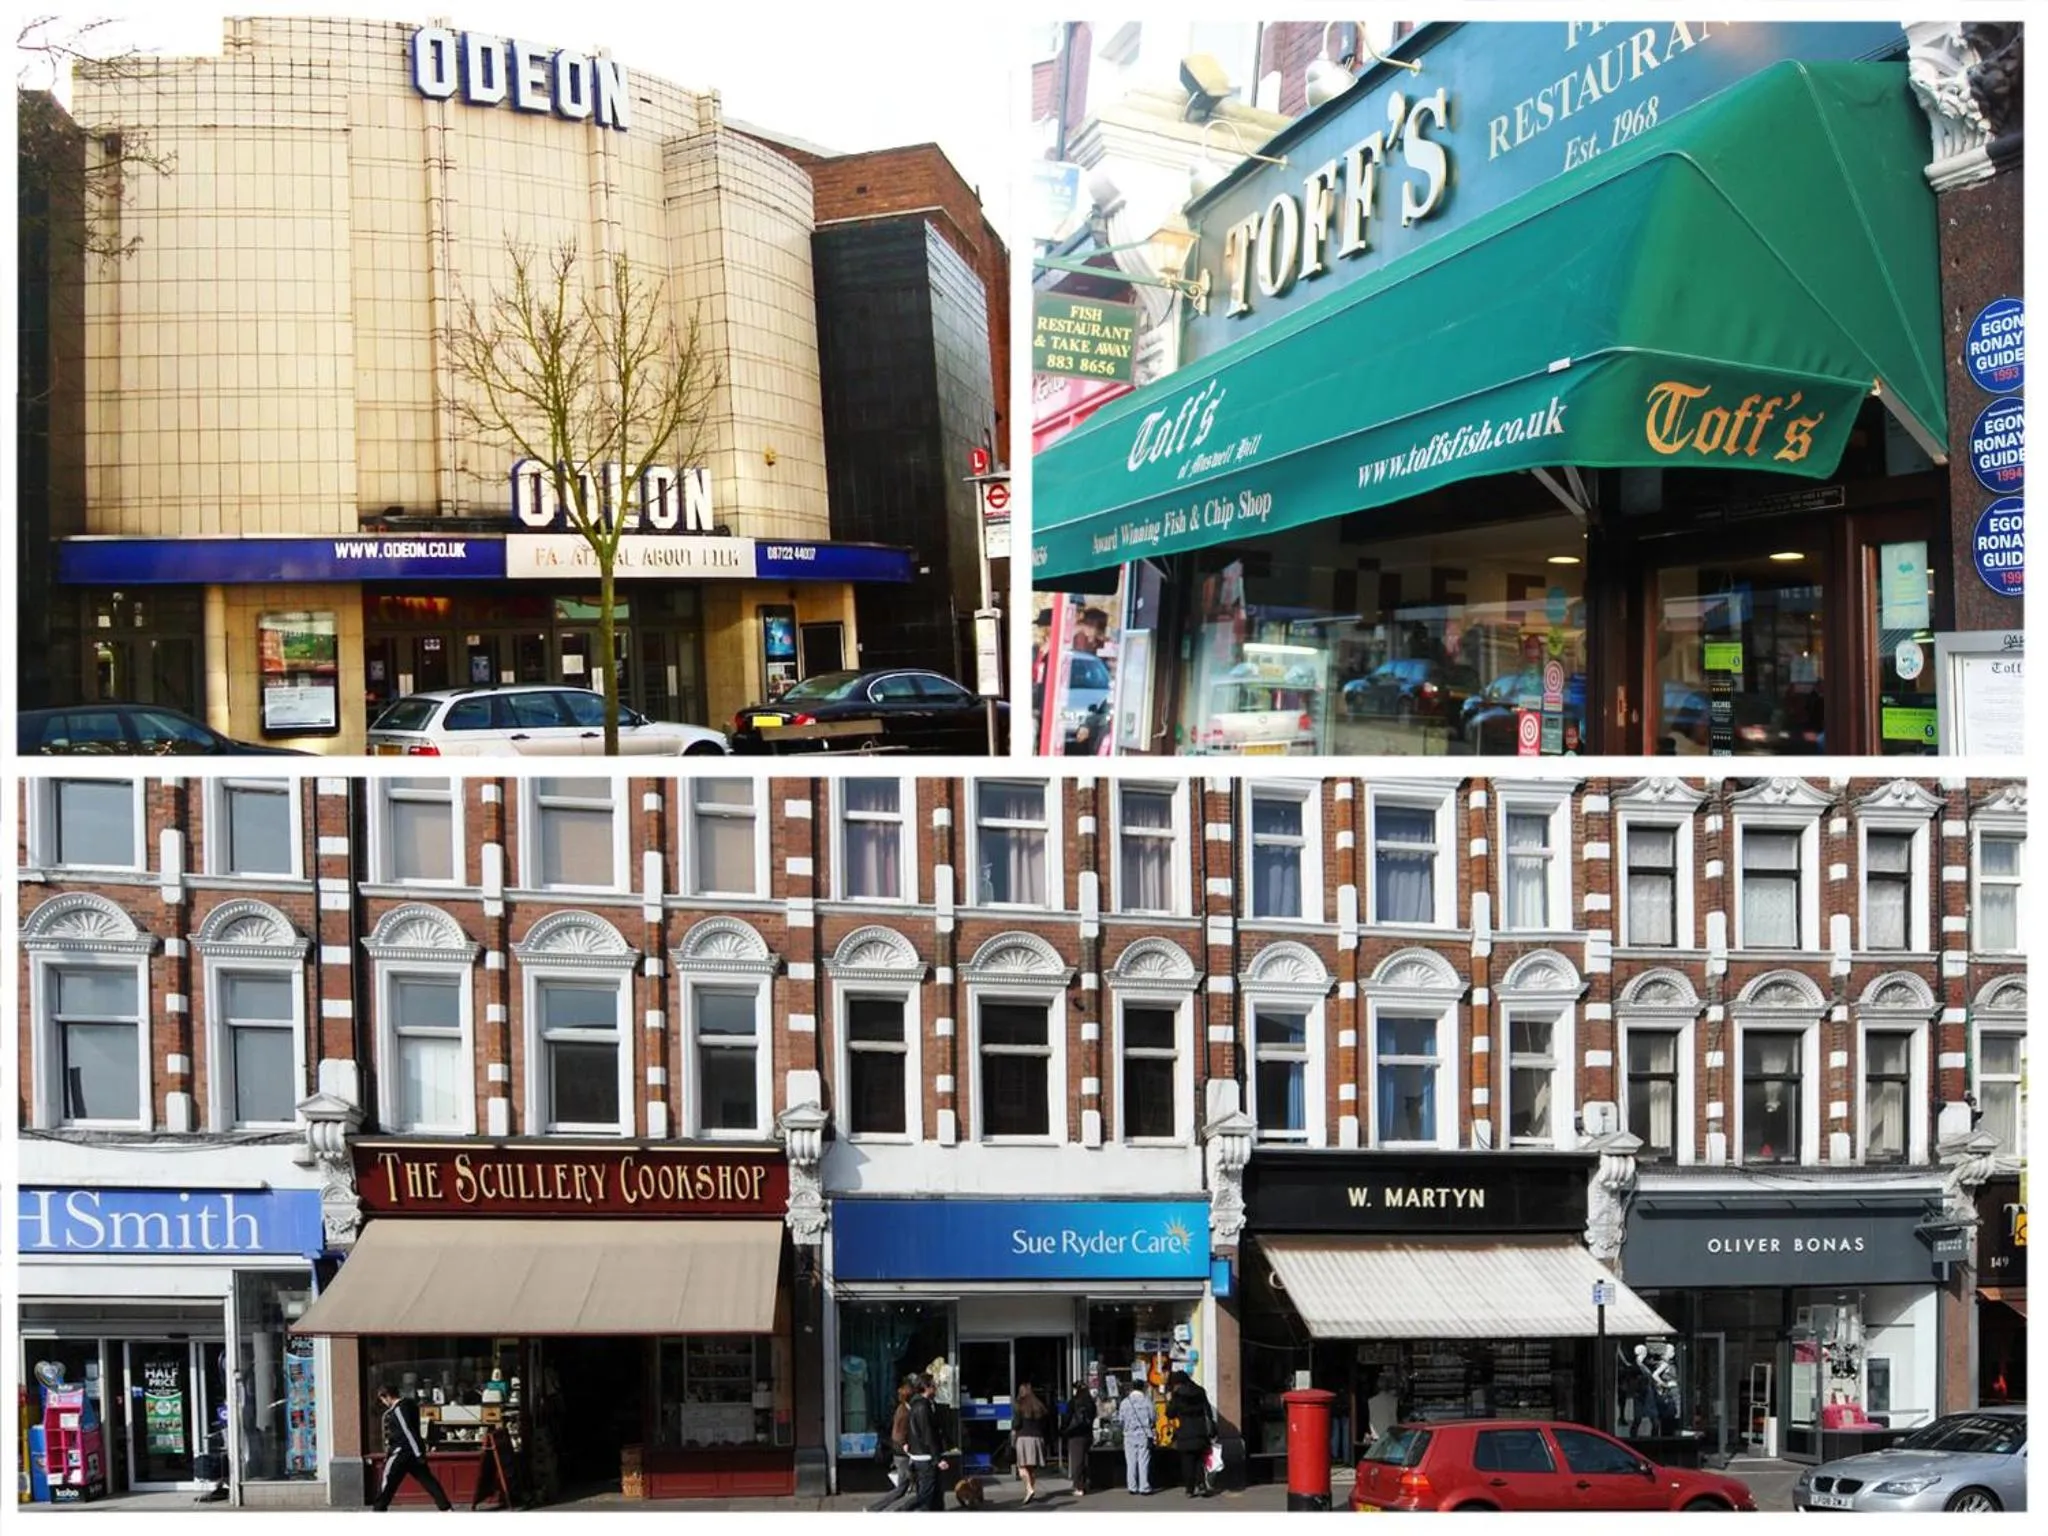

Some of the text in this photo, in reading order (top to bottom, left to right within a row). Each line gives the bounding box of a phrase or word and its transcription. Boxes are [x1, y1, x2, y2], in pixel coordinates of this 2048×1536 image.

[412, 27, 629, 132] ODEON
[1563, 96, 1659, 173] Est. 1968
[1225, 87, 1446, 318] TOFF'S
[1070, 305, 1103, 322] FISH
[1981, 314, 2024, 336] EGON
[1037, 316, 1132, 341] RESTAURANT
[1034, 333, 1131, 357] & TAKE AWAY
[1971, 330, 2022, 356] RONAY
[1047, 354, 1115, 376] 883 8656
[1976, 347, 2024, 371] GUIDE
[1128, 378, 1226, 472] Toff's
[1646, 381, 1825, 463] Toff's
[1358, 396, 1568, 489] www.toffsfish.co.uk
[1974, 431, 2024, 454] RONAY
[974, 453, 983, 468] L
[511, 458, 714, 530] ODEON
[1093, 489, 1273, 554] Award Winning Fish & Chip Shop
[335, 542, 467, 558] WWW.ODEON.CO.UK
[1978, 534, 2024, 551] RONA
[642, 549, 692, 567] ABOUT
[378, 1152, 765, 1204] THE SCULLERY COOKSHOP
[1347, 1187, 1485, 1208] W. MARTYN
[18, 1190, 262, 1250] HSmith
[1012, 1230, 1181, 1258] Sue Ryder Care
[1707, 1237, 1864, 1253] OLIVER BONAS
[1991, 1256, 2009, 1268] 149
[144, 1368, 178, 1379] HALF
